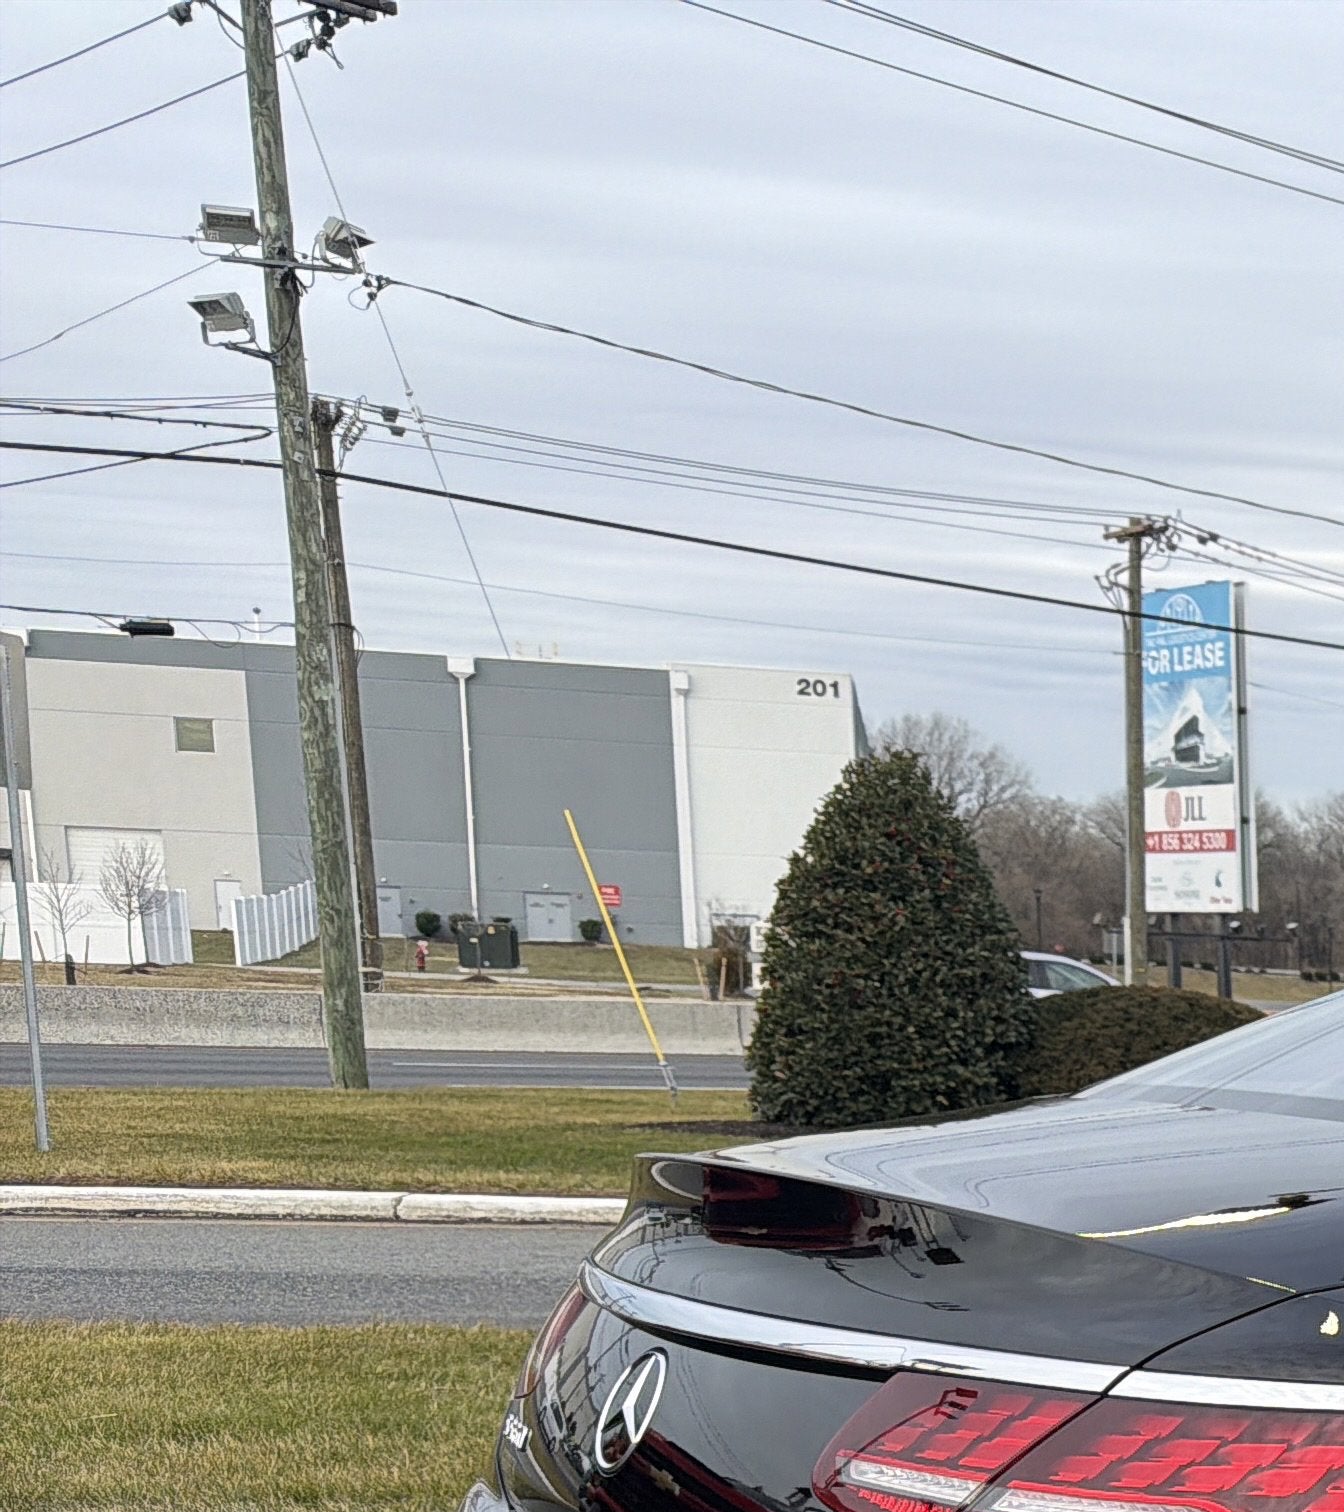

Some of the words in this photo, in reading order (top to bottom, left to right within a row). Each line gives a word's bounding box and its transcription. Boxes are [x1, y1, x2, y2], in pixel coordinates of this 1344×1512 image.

[1173, 641, 1225, 672] LEASE
[796, 678, 840, 698] 201
[1183, 795, 1207, 822] JLL
[1181, 832, 1201, 851] 324
